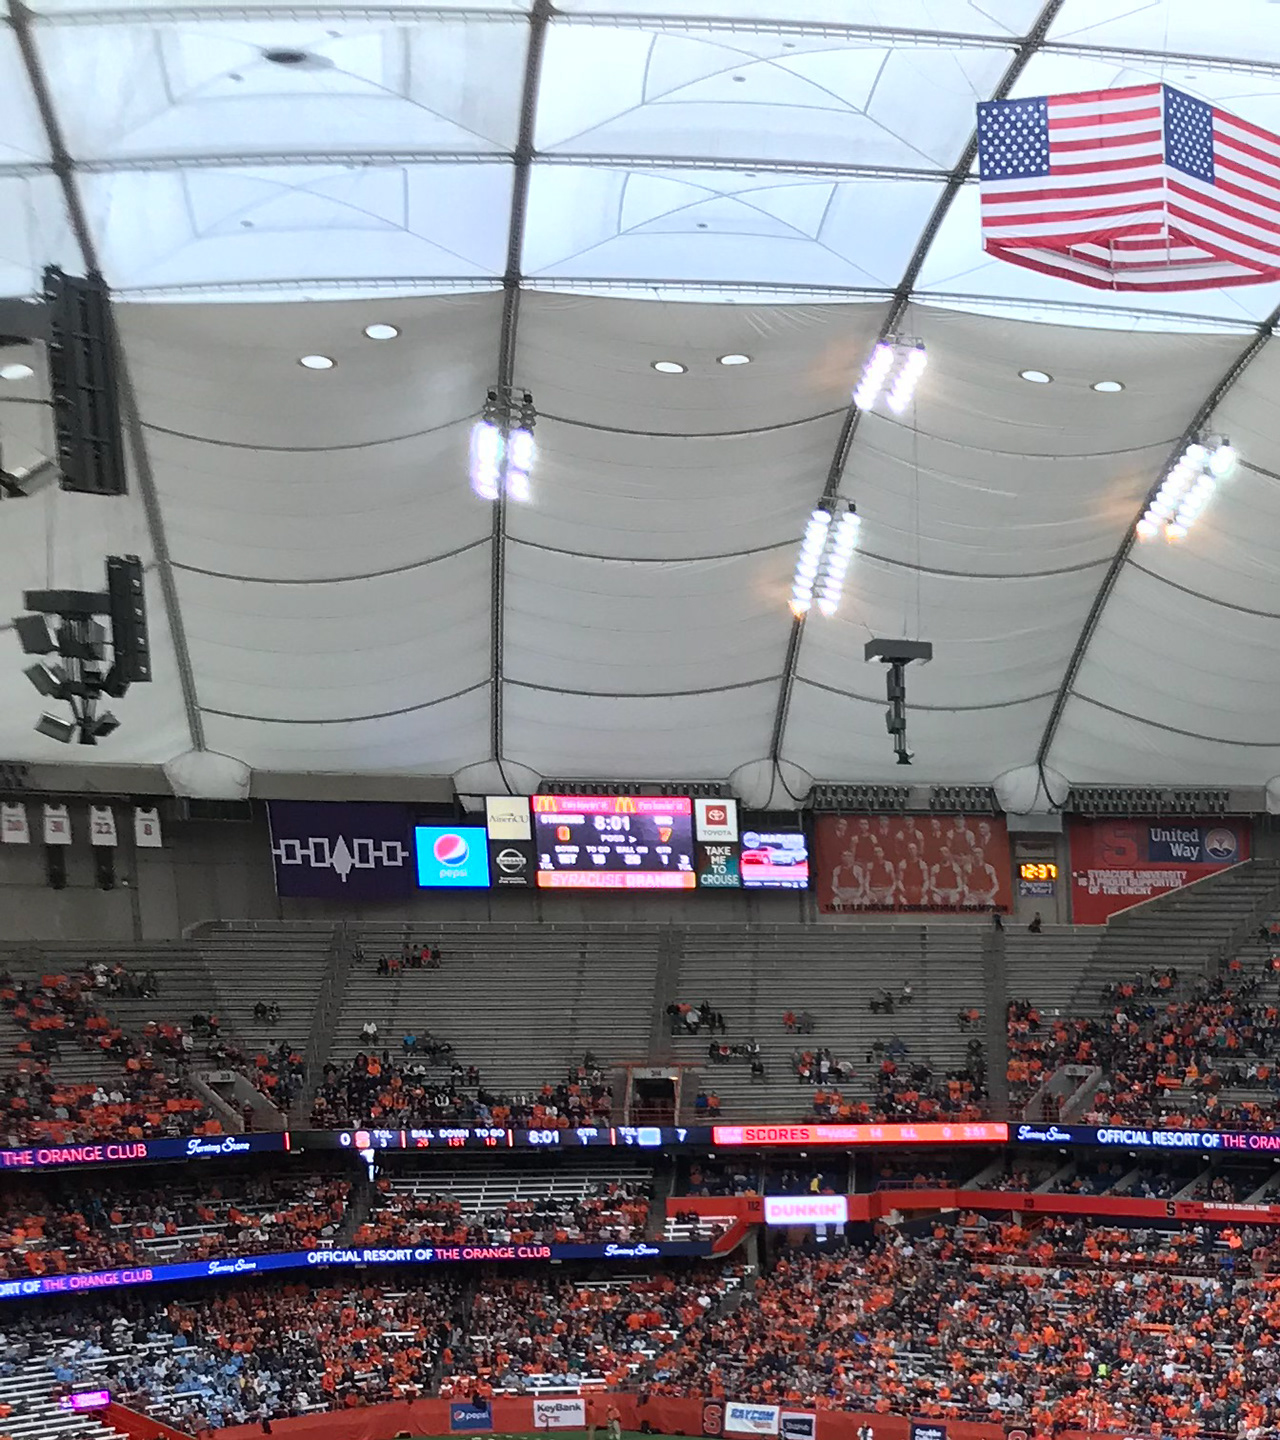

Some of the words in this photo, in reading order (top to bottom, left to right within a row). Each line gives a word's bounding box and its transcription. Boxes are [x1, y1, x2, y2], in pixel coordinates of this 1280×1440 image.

[594, 815, 631, 831] 8:01
[657, 826, 673, 843] 7
[1151, 827, 1200, 842] United
[705, 845, 732, 856] TAKE
[1169, 843, 1200, 861] Way
[710, 856, 727, 865] ME
[439, 866, 468, 880] pepsi
[712, 865, 727, 874] TO
[1020, 863, 1058, 879] 12:37
[550, 874, 624, 887] SYRACUSE
[701, 874, 740, 885] CROUSE
[439, 1129, 469, 1139] DOWN
[528, 1131, 560, 1145] 8:01
[745, 1128, 810, 1141] SCORES
[1097, 1129, 1150, 1145] OFFICIAL
[1152, 1131, 1200, 1147] RESORT
[1202, 1132, 1220, 1147] OF
[1221, 1133, 1247, 1148] THE
[3, 1150, 34, 1166] THE
[38, 1145, 103, 1164] ORANGE
[107, 1143, 147, 1159] CLUB
[770, 1203, 841, 1218] DUNKIN'
[307, 1249, 362, 1264] OFFICIAL
[364, 1249, 413, 1262] RESORT
[415, 1248, 433, 1261] OF
[435, 1248, 460, 1260] THE
[462, 1247, 515, 1260] ORANGE
[518, 1246, 551, 1259] CLUB
[23, 1280, 41, 1294] OF
[43, 1277, 67, 1291] THE
[69, 1273, 120, 1289] ORANGE
[122, 1269, 153, 1284] CLUB
[466, 1409, 490, 1421] pepsi
[537, 1404, 583, 1415] KeyBank
[731, 1408, 775, 1421] RAYCOM
[702, 1404, 723, 1435] S
